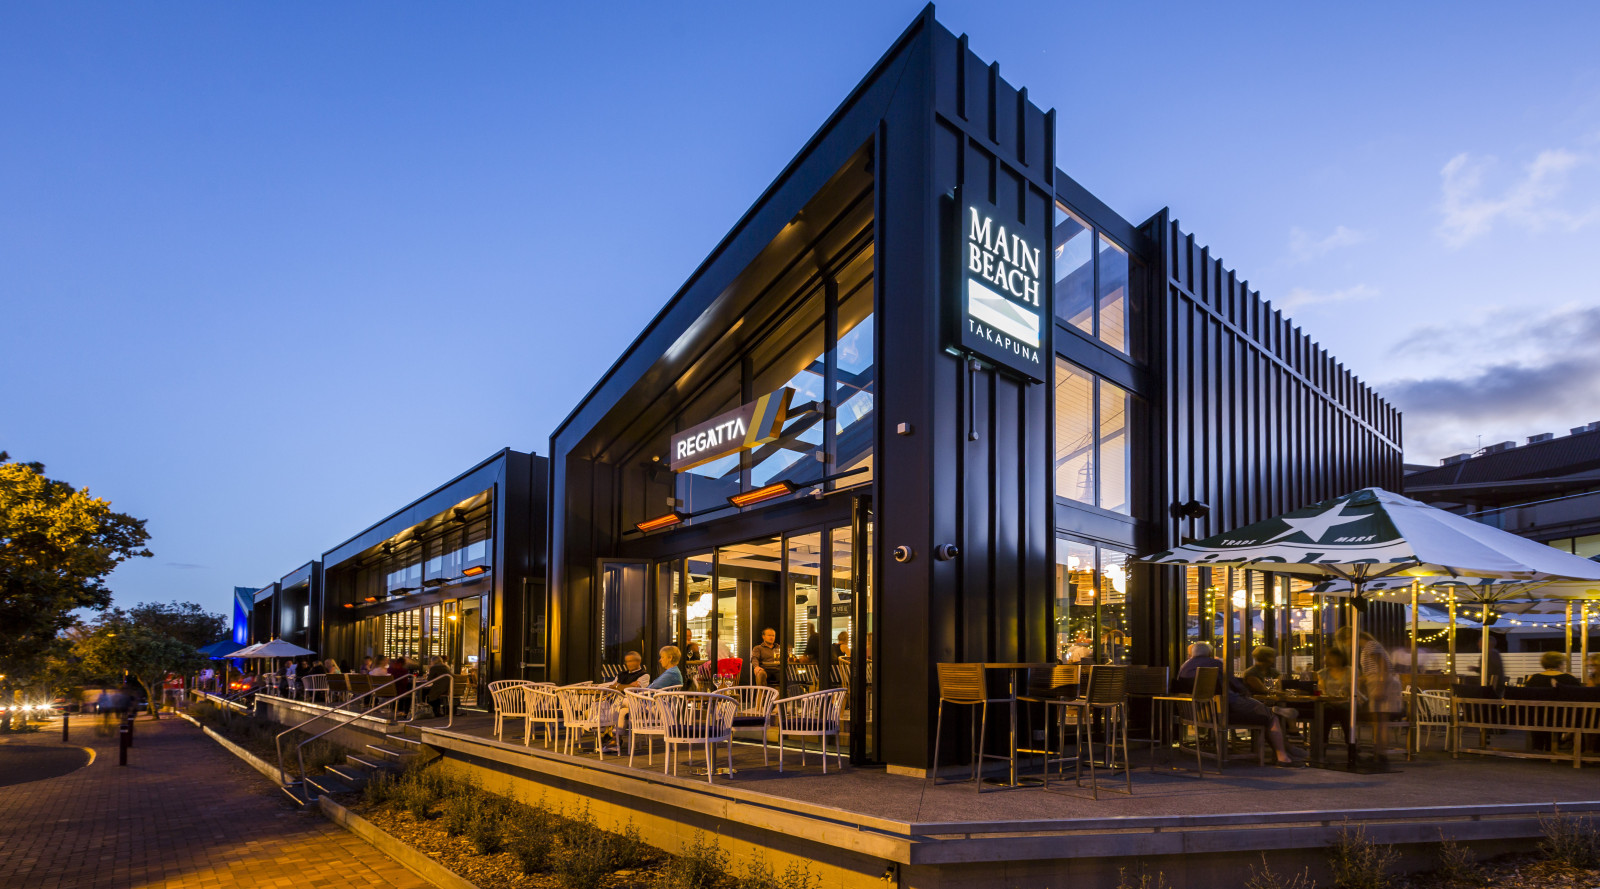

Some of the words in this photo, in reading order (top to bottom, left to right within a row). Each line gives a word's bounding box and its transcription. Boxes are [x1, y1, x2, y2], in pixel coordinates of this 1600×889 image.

[969, 206, 1040, 279] MAIN
[968, 242, 1040, 307] BEACH
[969, 319, 1040, 364] TAKAPUNA
[677, 417, 746, 460] REGATTA
[1333, 534, 1377, 543] MARK
